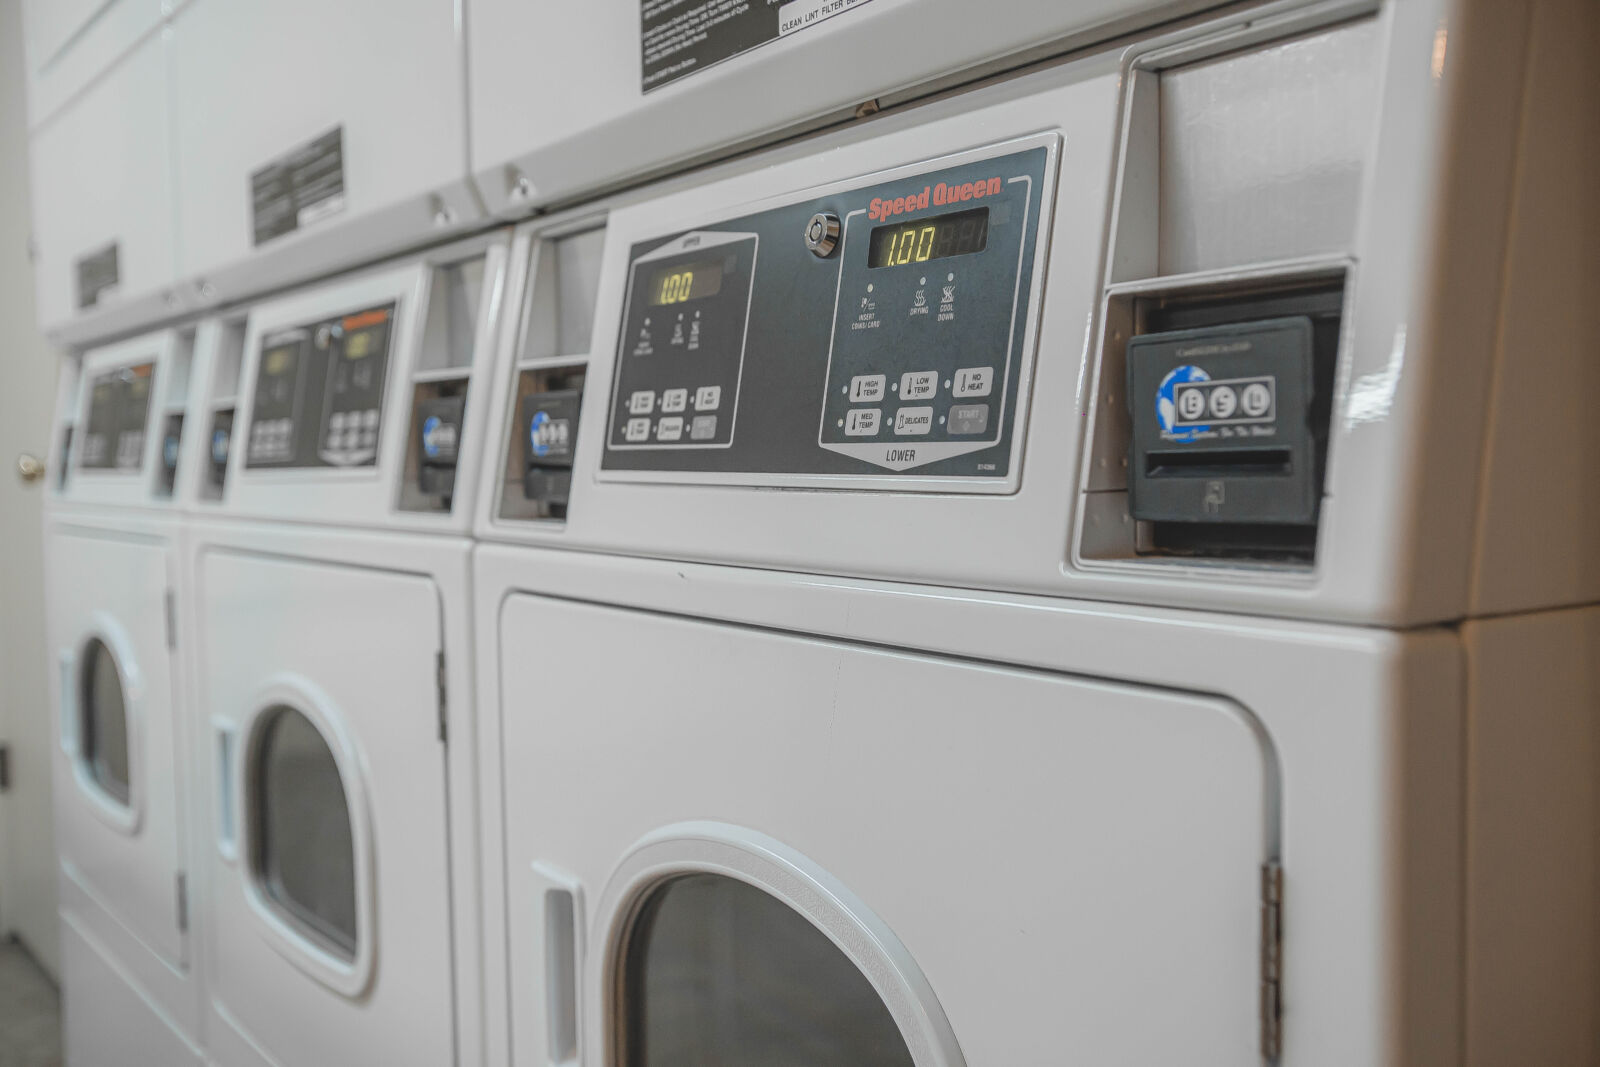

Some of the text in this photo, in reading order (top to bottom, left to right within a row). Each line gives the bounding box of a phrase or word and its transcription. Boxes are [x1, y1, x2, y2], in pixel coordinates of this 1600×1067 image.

[781, 0, 844, 32] CLEAN LINT FILTER
[868, 176, 1002, 222] Speed Queen
[887, 226, 936, 266] 1.00
[909, 306, 929, 316] DRYING
[939, 303, 954, 312] COOL
[858, 312, 875, 321] INSERT
[937, 312, 954, 322] DOWN
[916, 377, 930, 385] LOW
[972, 373, 982, 381] NO
[864, 380, 879, 388] HIGH
[968, 382, 984, 390] HEAT
[863, 388, 878, 397] TEMP
[914, 386, 930, 394] TEMP
[861, 412, 873, 420] MED
[958, 409, 980, 419] START
[859, 421, 874, 429] TEMP
[905, 416, 929, 425] DELICATES
[886, 449, 916, 462] LOWER
